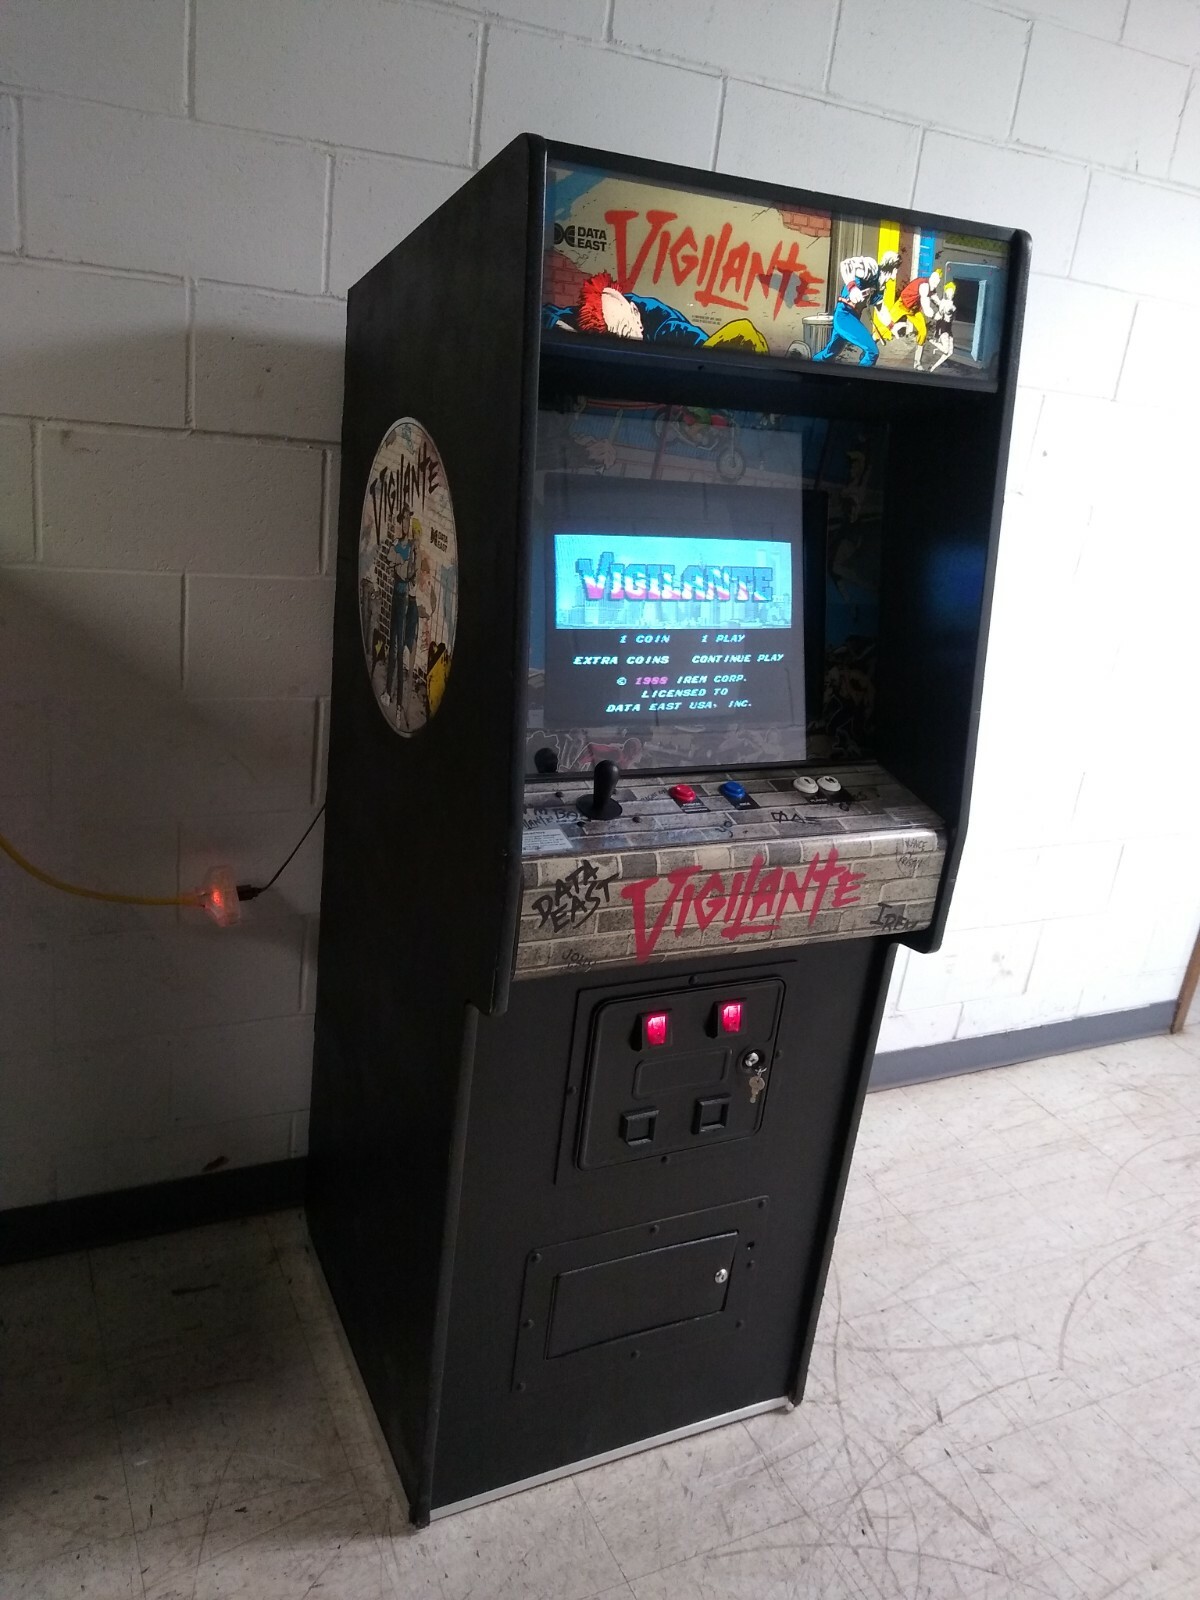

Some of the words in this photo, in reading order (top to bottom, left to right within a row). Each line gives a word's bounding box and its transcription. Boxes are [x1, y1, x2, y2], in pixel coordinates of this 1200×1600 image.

[577, 226, 607, 241] DATA
[577, 236, 608, 252] EAST
[575, 551, 773, 603] VIGILANTE
[619, 635, 627, 644] 1
[635, 634, 670, 644] COIN
[701, 634, 708, 643] 1
[715, 634, 745, 643] PLAY
[573, 655, 618, 665] EXTRA
[626, 655, 670, 665] COINS
[692, 654, 752, 664] CONTINUE
[757, 653, 784, 662] PLAY
[635, 676, 669, 685] 1988
[677, 675, 708, 684] IREM
[713, 674, 747, 683] CORP.
[641, 688, 706, 698] LICENSED
[713, 687, 728, 696] TO
[606, 703, 640, 713] DATA
[649, 702, 682, 711] EAST
[728, 700, 752, 708] INC.
[531, 859, 600, 929] DATA
[551, 872, 620, 934] EAST
[620, 844, 866, 964] VIGILANTE
